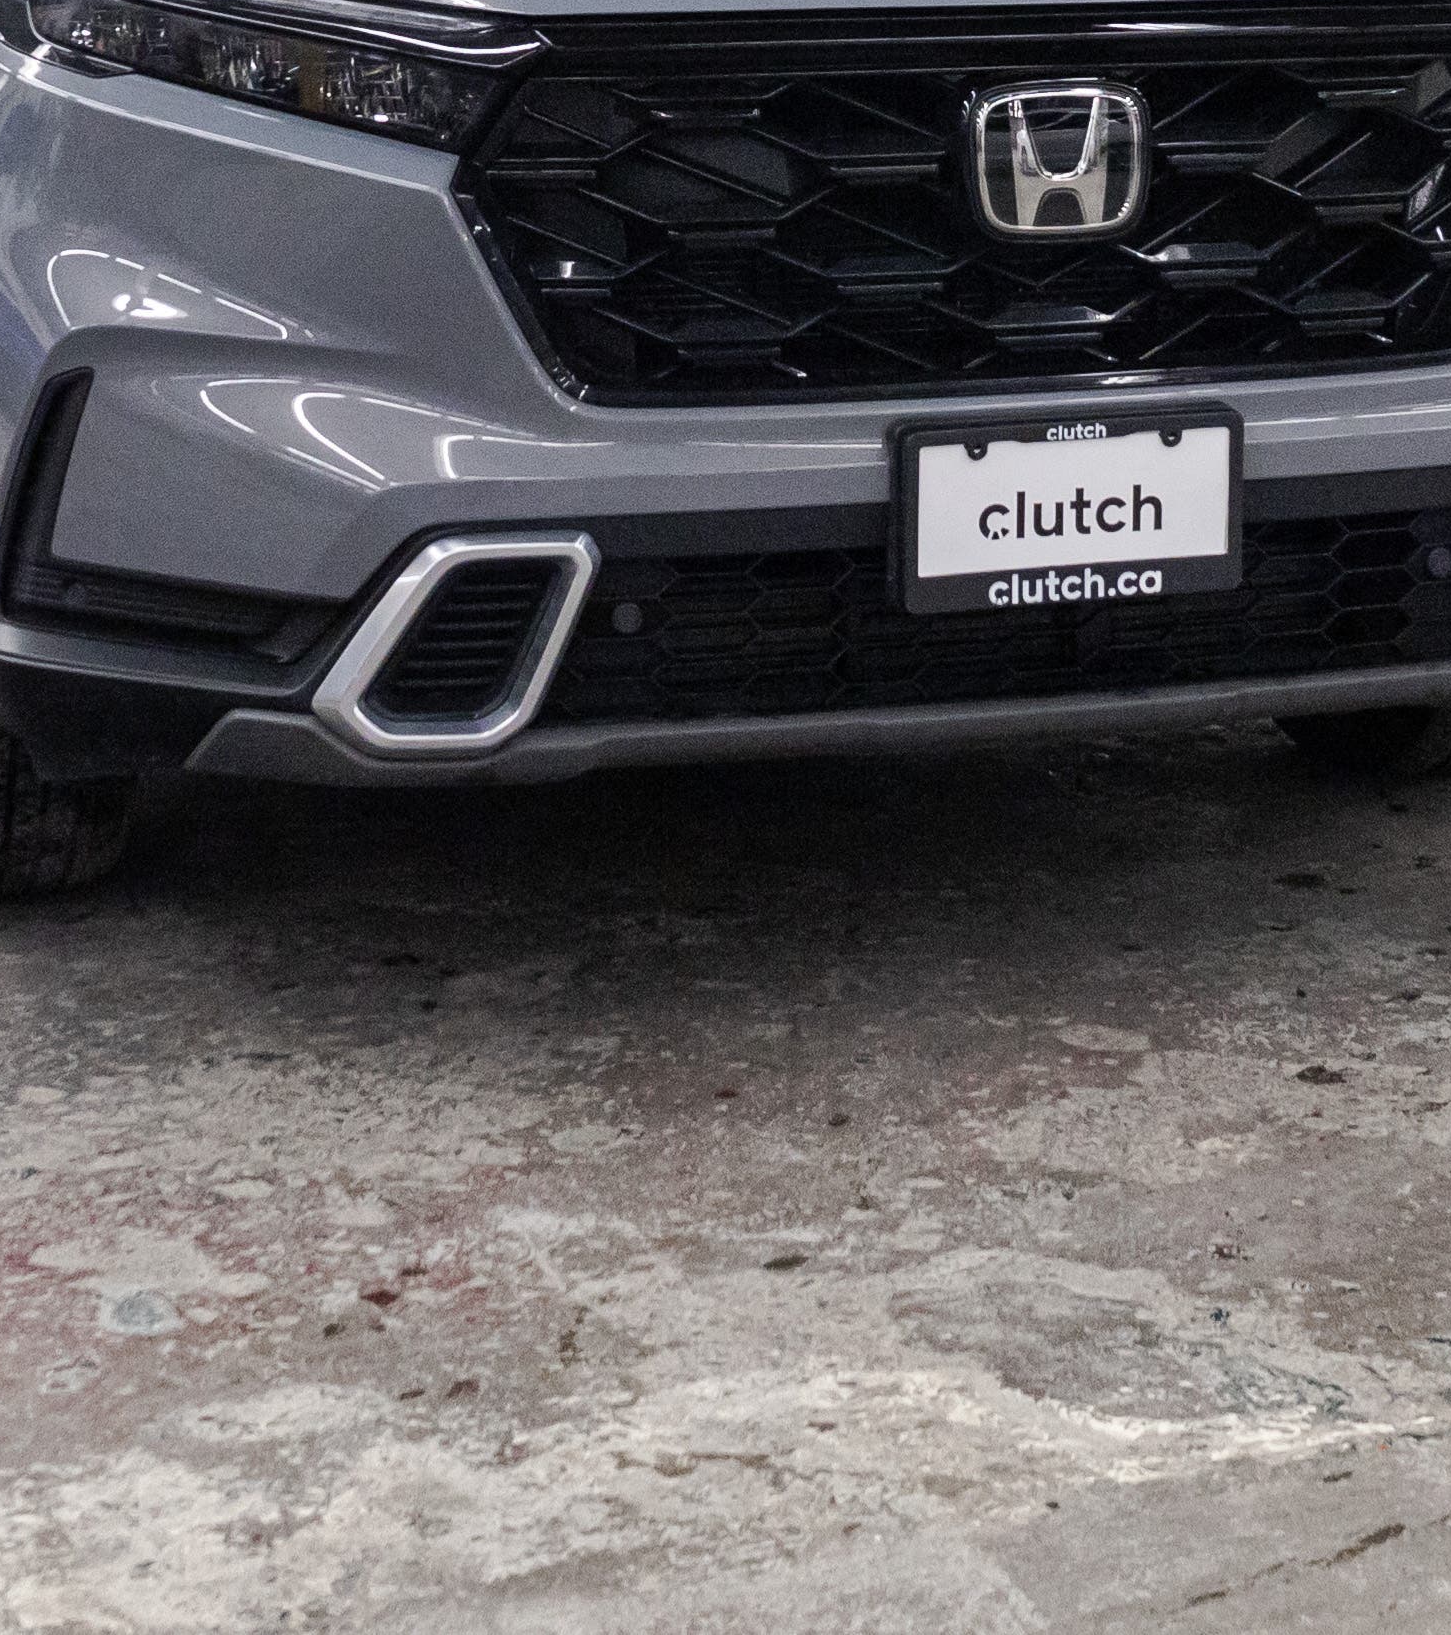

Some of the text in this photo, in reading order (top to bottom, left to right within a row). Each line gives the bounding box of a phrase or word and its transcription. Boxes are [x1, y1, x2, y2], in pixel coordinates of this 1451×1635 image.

[1046, 422, 1107, 441] clutch
[978, 483, 1163, 541] clutch
[988, 567, 1163, 606] clutch.ca
